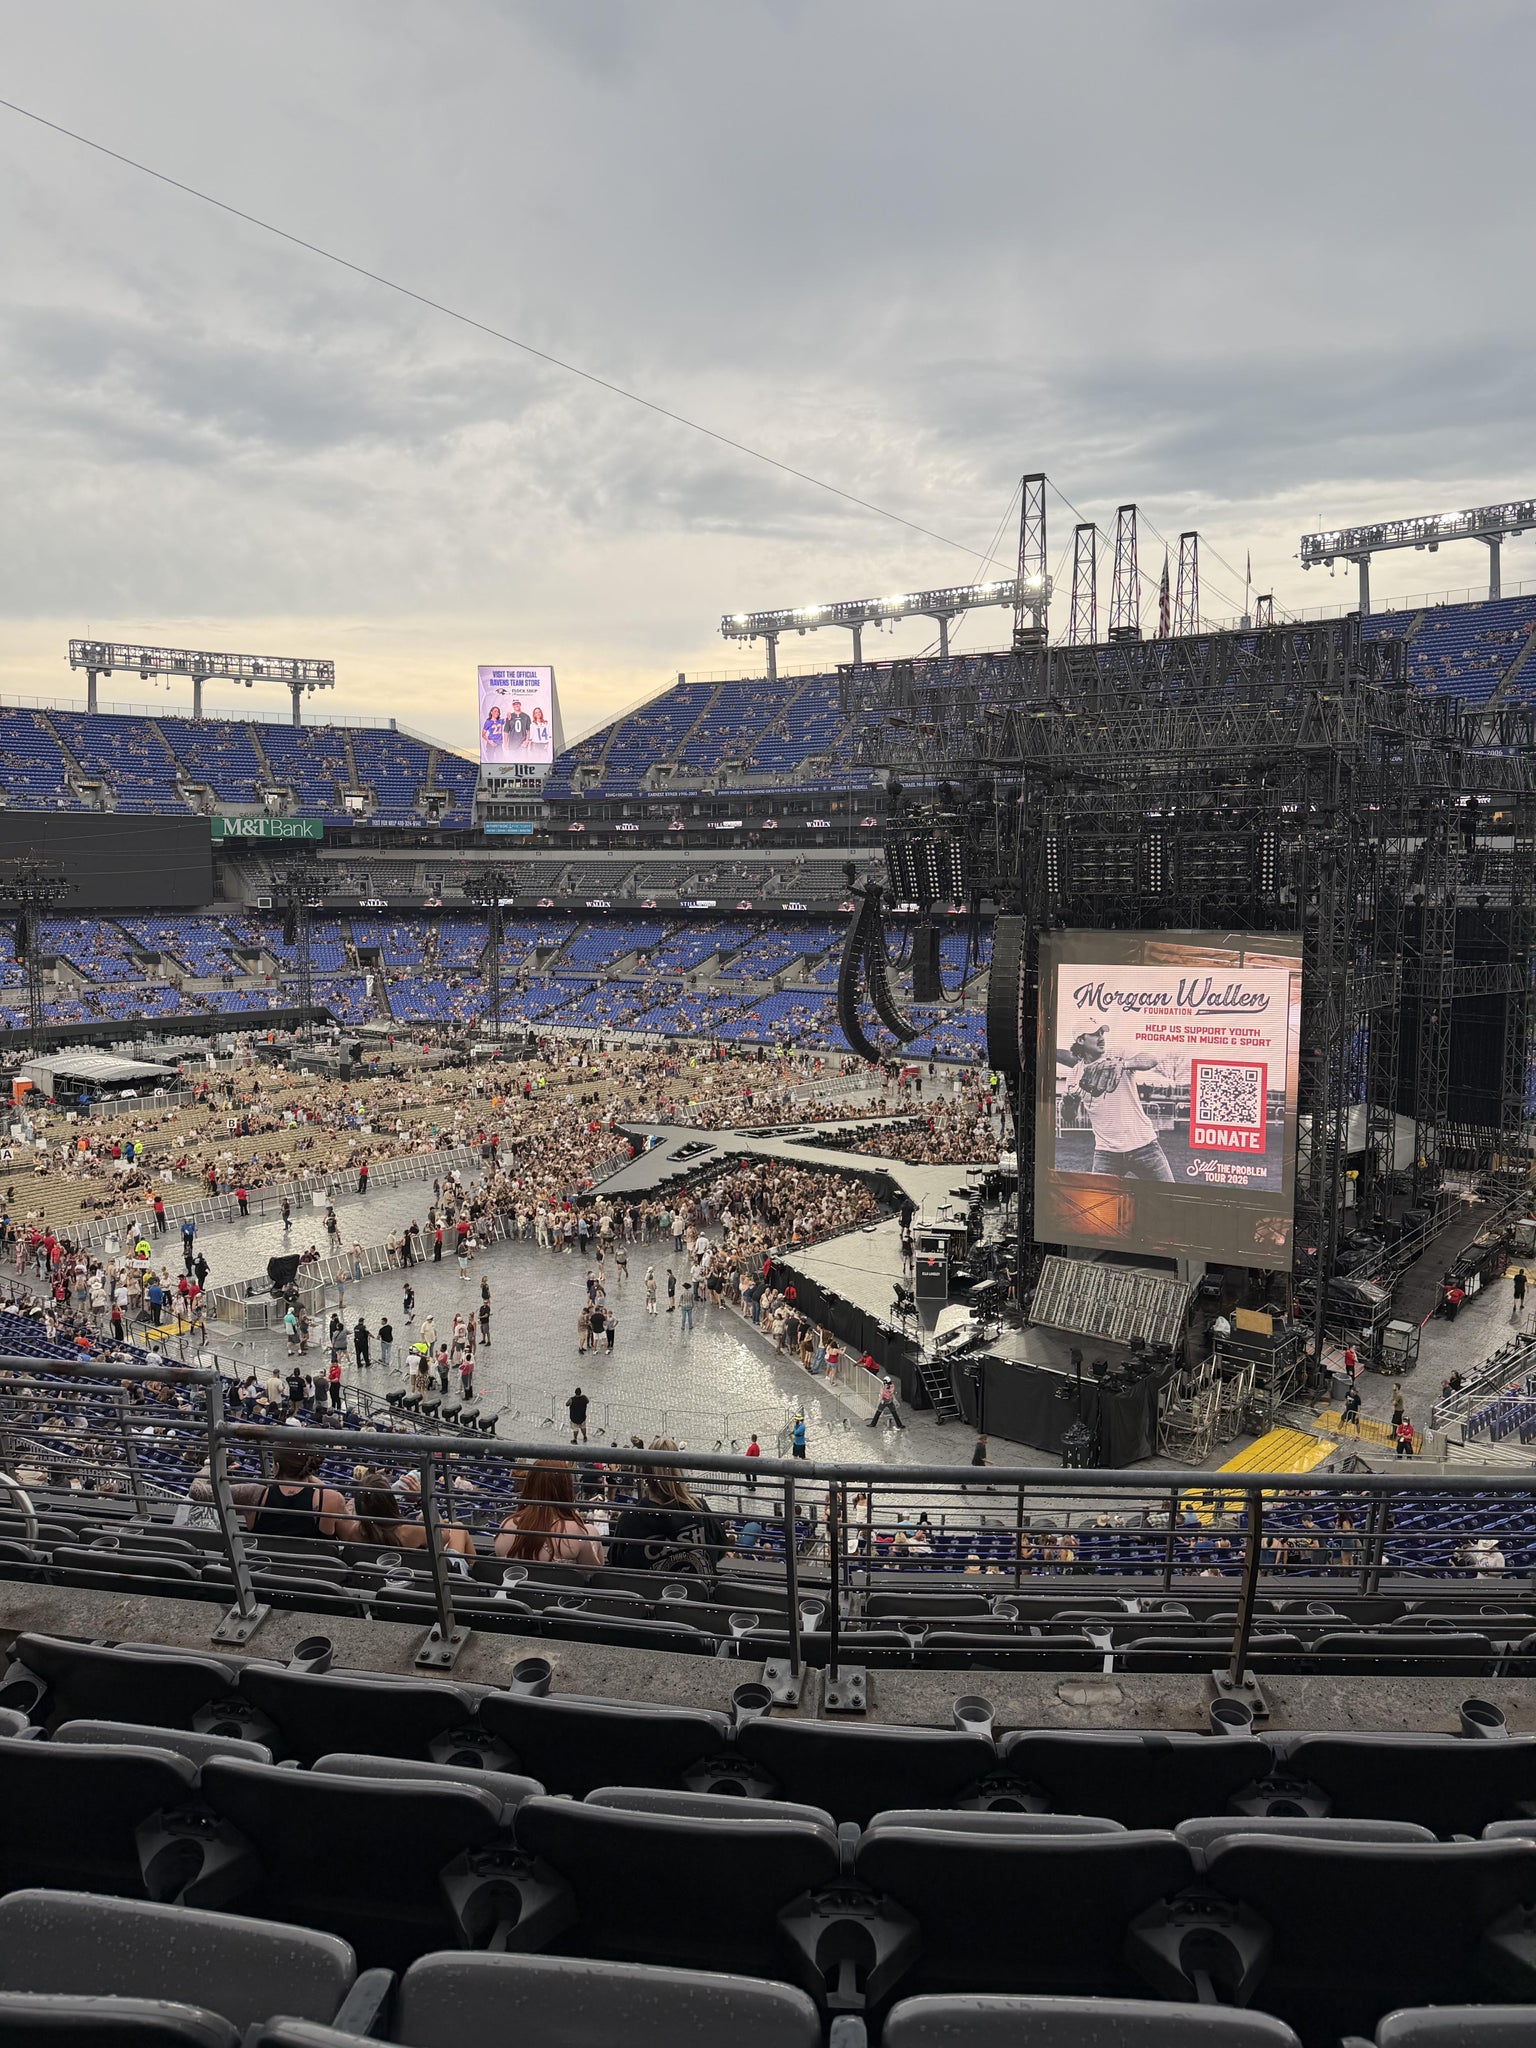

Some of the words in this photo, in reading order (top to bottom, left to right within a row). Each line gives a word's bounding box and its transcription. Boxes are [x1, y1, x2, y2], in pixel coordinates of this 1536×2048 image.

[492, 670, 505, 678] VISIT
[506, 670, 516, 678] THE
[514, 720, 522, 733] 0
[537, 727, 548, 741] 14
[514, 763, 536, 778] Lite
[222, 817, 269, 836] M&T
[270, 819, 313, 837] Bank
[1073, 982, 1173, 1013] Morgan
[1176, 977, 1271, 1016] Wallen
[1143, 1007, 1193, 1016] FOUNDATION
[1145, 1024, 1167, 1033] HELP
[1169, 1026, 1182, 1034] US
[1184, 1026, 1227, 1036] SUPPORT
[1229, 1028, 1261, 1037] YOUTH
[1135, 1034, 1185, 1043] PROGRAMS
[1199, 1036, 1229, 1045] MUSIC
[1240, 1039, 1271, 1047] SPORT
[228, 1119, 235, 1128] B
[1194, 1127, 1260, 1149] DONATE
[3, 1149, 12, 1159] A
[1186, 1158, 1218, 1177] Still
[1216, 1163, 1231, 1174] THE
[1231, 1165, 1267, 1177] PROBLEM
[1205, 1172, 1226, 1182] TOUR
[1227, 1174, 1249, 1185] 2026
[644, 1524, 706, 1560] CASH
